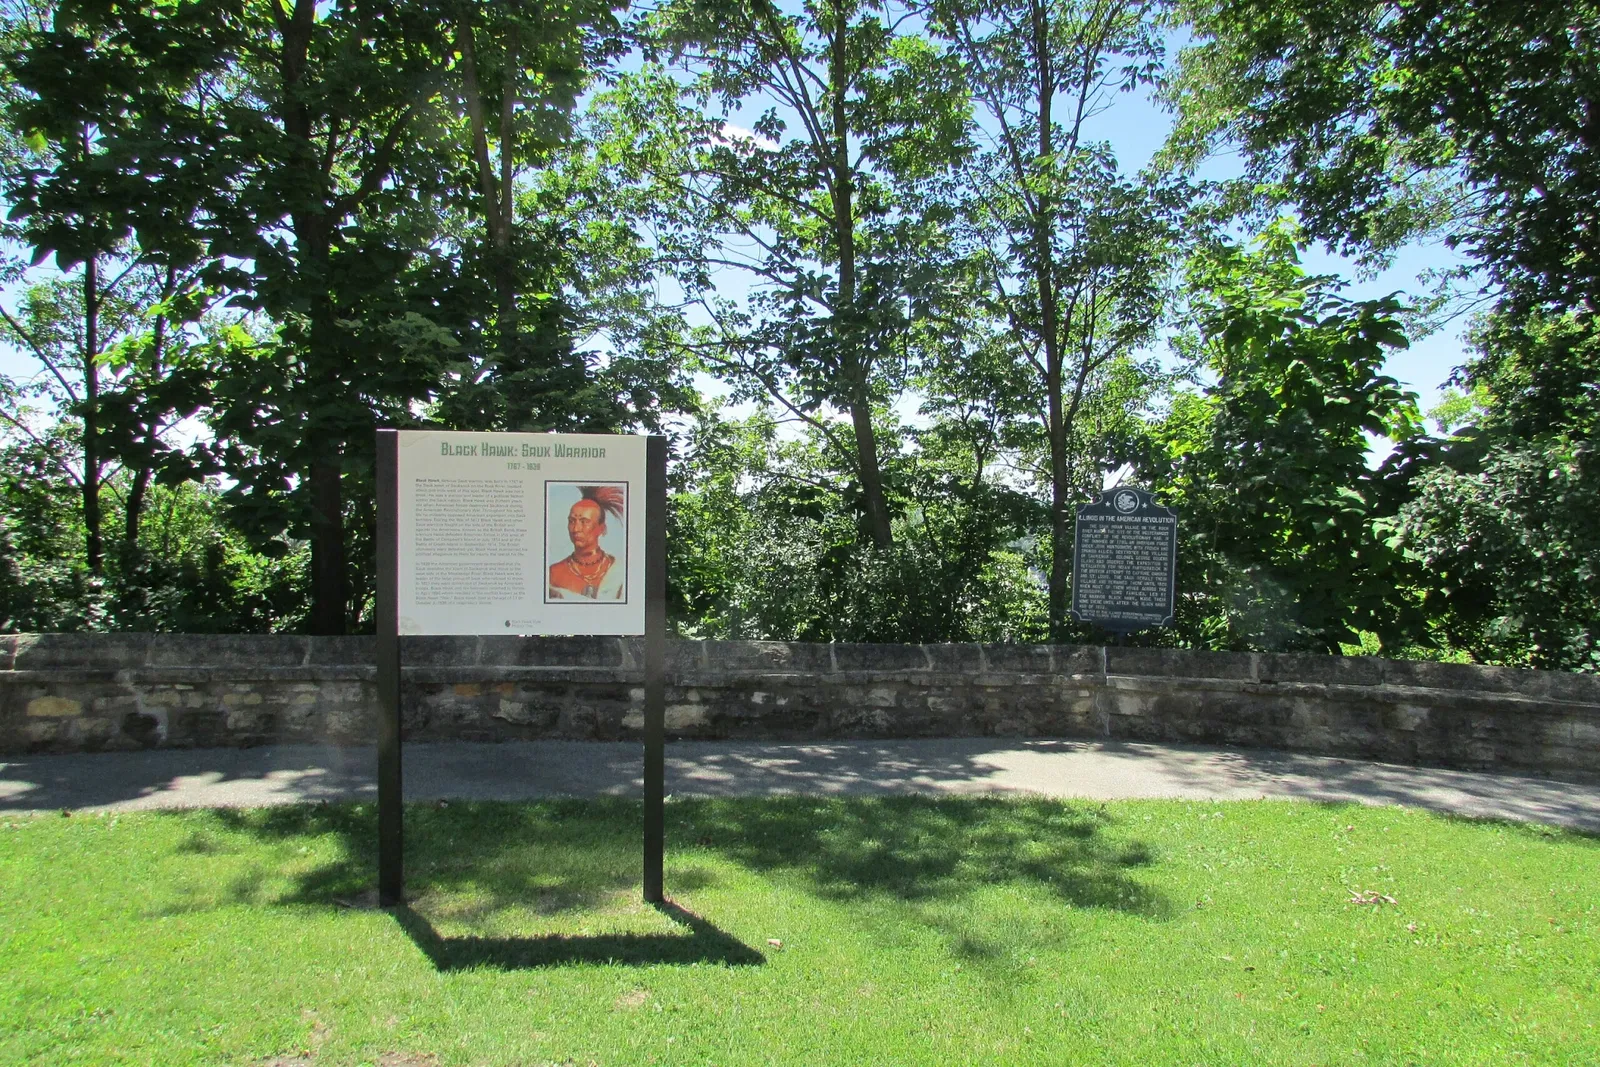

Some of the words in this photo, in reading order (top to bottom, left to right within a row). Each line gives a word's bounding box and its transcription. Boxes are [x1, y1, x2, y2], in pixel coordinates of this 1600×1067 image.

[441, 442, 477, 456] BLACK
[481, 442, 518, 457] HAWK:
[521, 443, 550, 457] SAUK
[554, 444, 606, 458] WARRIOR
